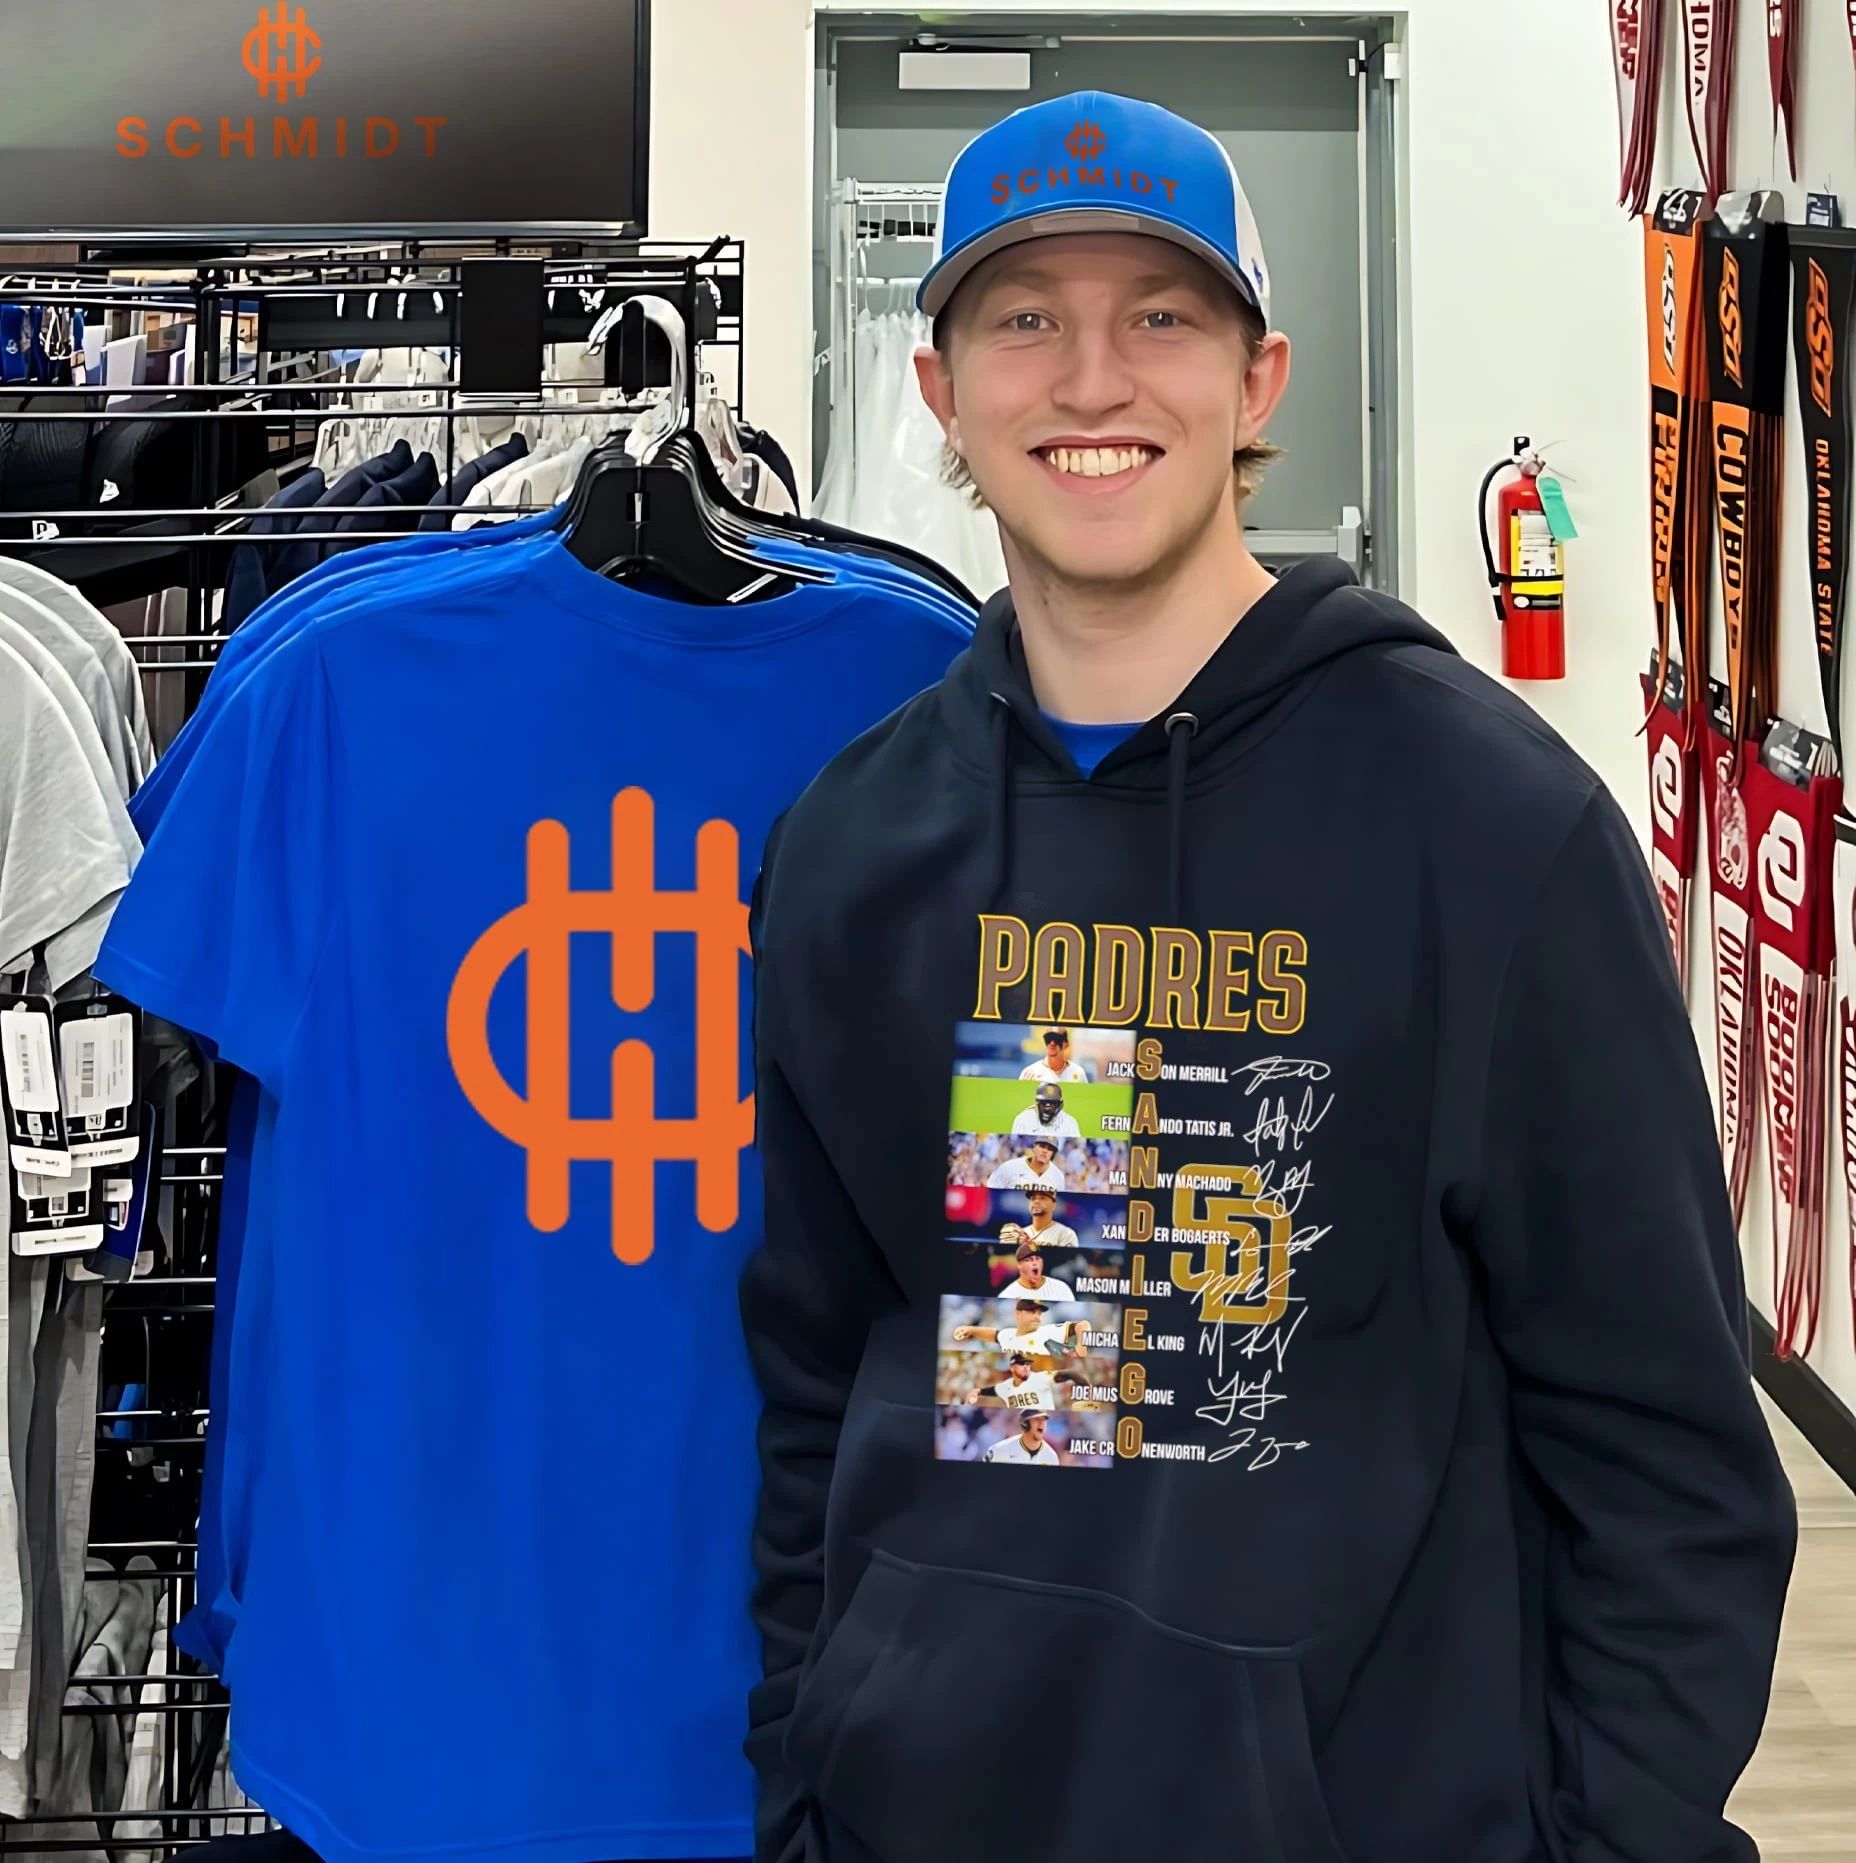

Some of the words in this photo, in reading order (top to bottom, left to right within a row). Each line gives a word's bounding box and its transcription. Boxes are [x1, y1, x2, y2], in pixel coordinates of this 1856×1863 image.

[116, 116, 448, 159] SCHMIDT
[991, 166, 1181, 204] SCHMIDT
[1816, 438, 1831, 570] OKLAHOMA
[972, 914, 1307, 1034] PADRES
[1179, 1066, 1228, 1083] MERRILL
[1185, 1120, 1216, 1137] TATIS
[1217, 1122, 1234, 1138] JR.
[1175, 1174, 1232, 1192] MACHADO
[1171, 1227, 1231, 1246] BOGAERTS
[1076, 1277, 1117, 1294] MASON
[1157, 1335, 1185, 1351] KING
[1071, 1385, 1089, 1401] JOE
[1069, 1439, 1097, 1456] JAKE
